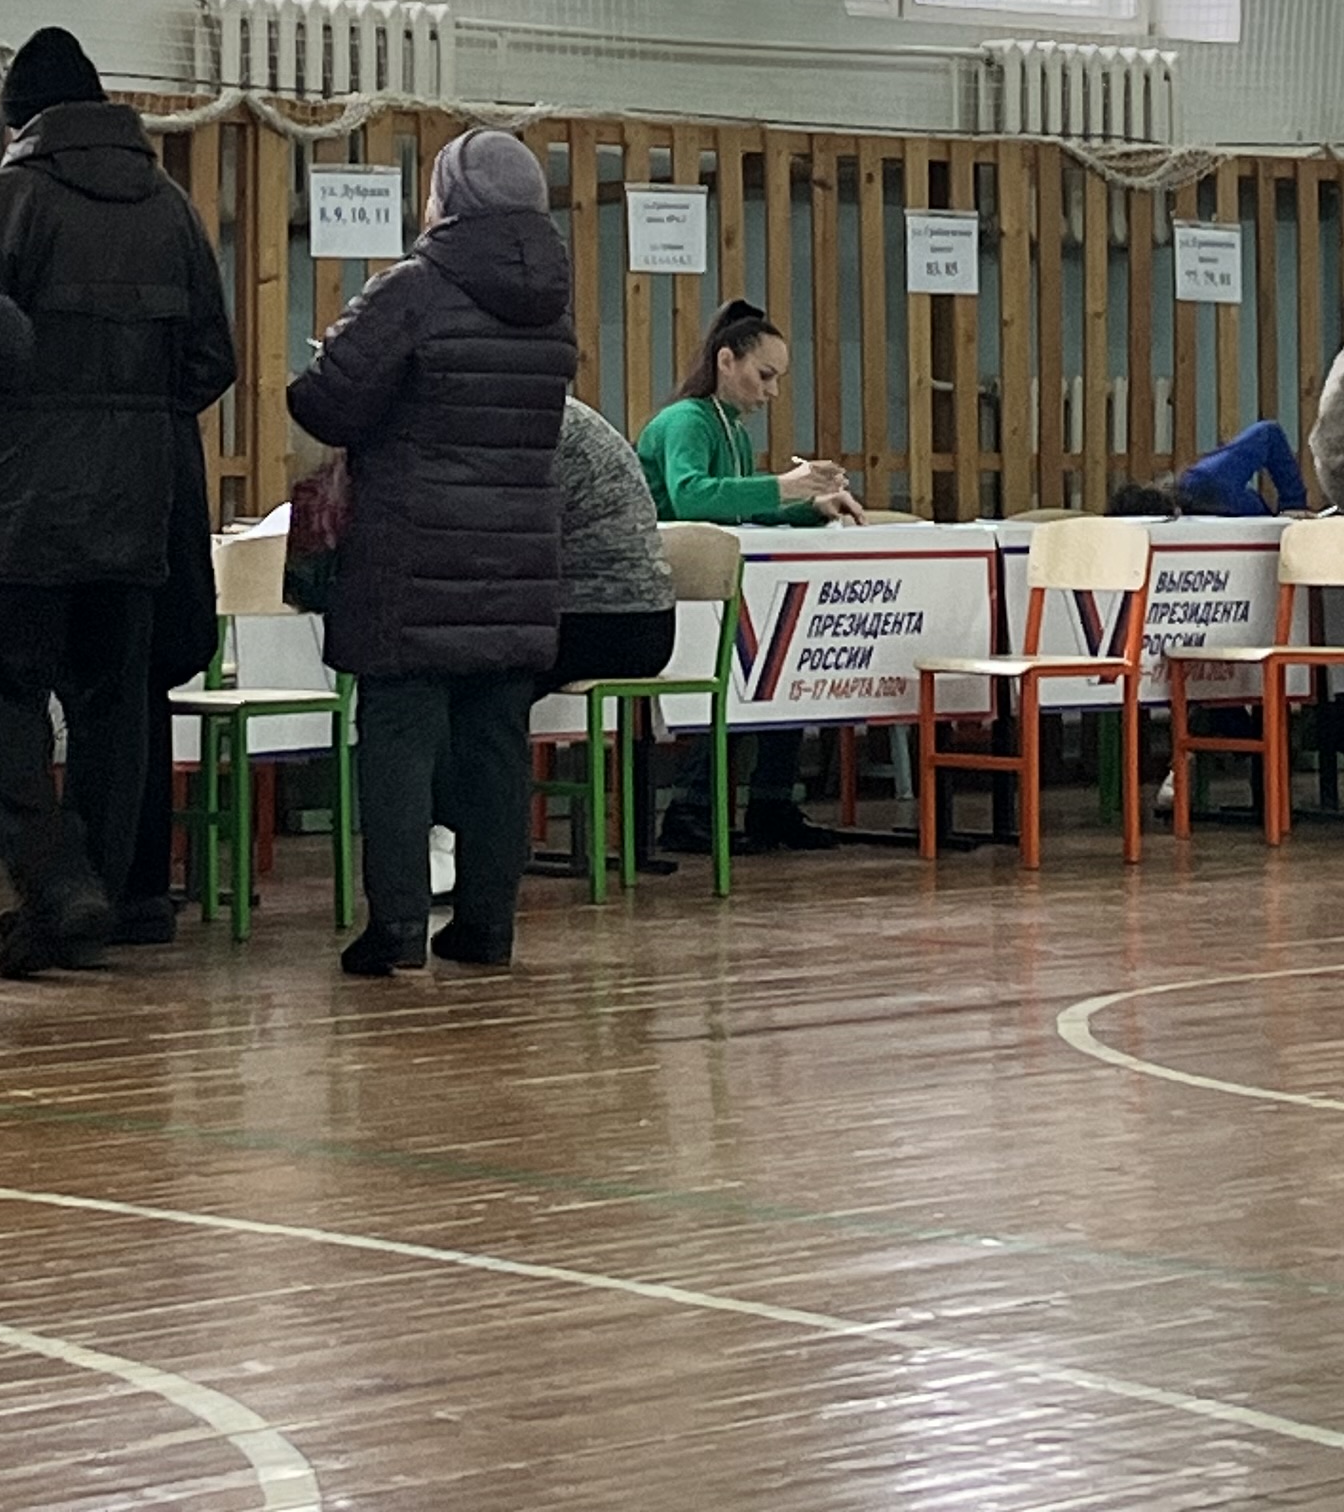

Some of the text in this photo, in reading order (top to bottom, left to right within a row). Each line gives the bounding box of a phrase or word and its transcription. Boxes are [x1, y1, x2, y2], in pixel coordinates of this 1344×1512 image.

[334, 206, 348, 225] 9,
[350, 207, 371, 225] 10,
[375, 207, 391, 224] 11
[818, 578, 903, 605] ВЫБОРЫ
[1154, 569, 1230, 594] ВЫБОРЫ
[807, 610, 923, 639] ПРЕЗИДЕНТА
[1145, 600, 1250, 628] ПРЕЗИДЕНТА
[796, 645, 874, 672] РОССИИ
[827, 676, 874, 700] МАРТА
